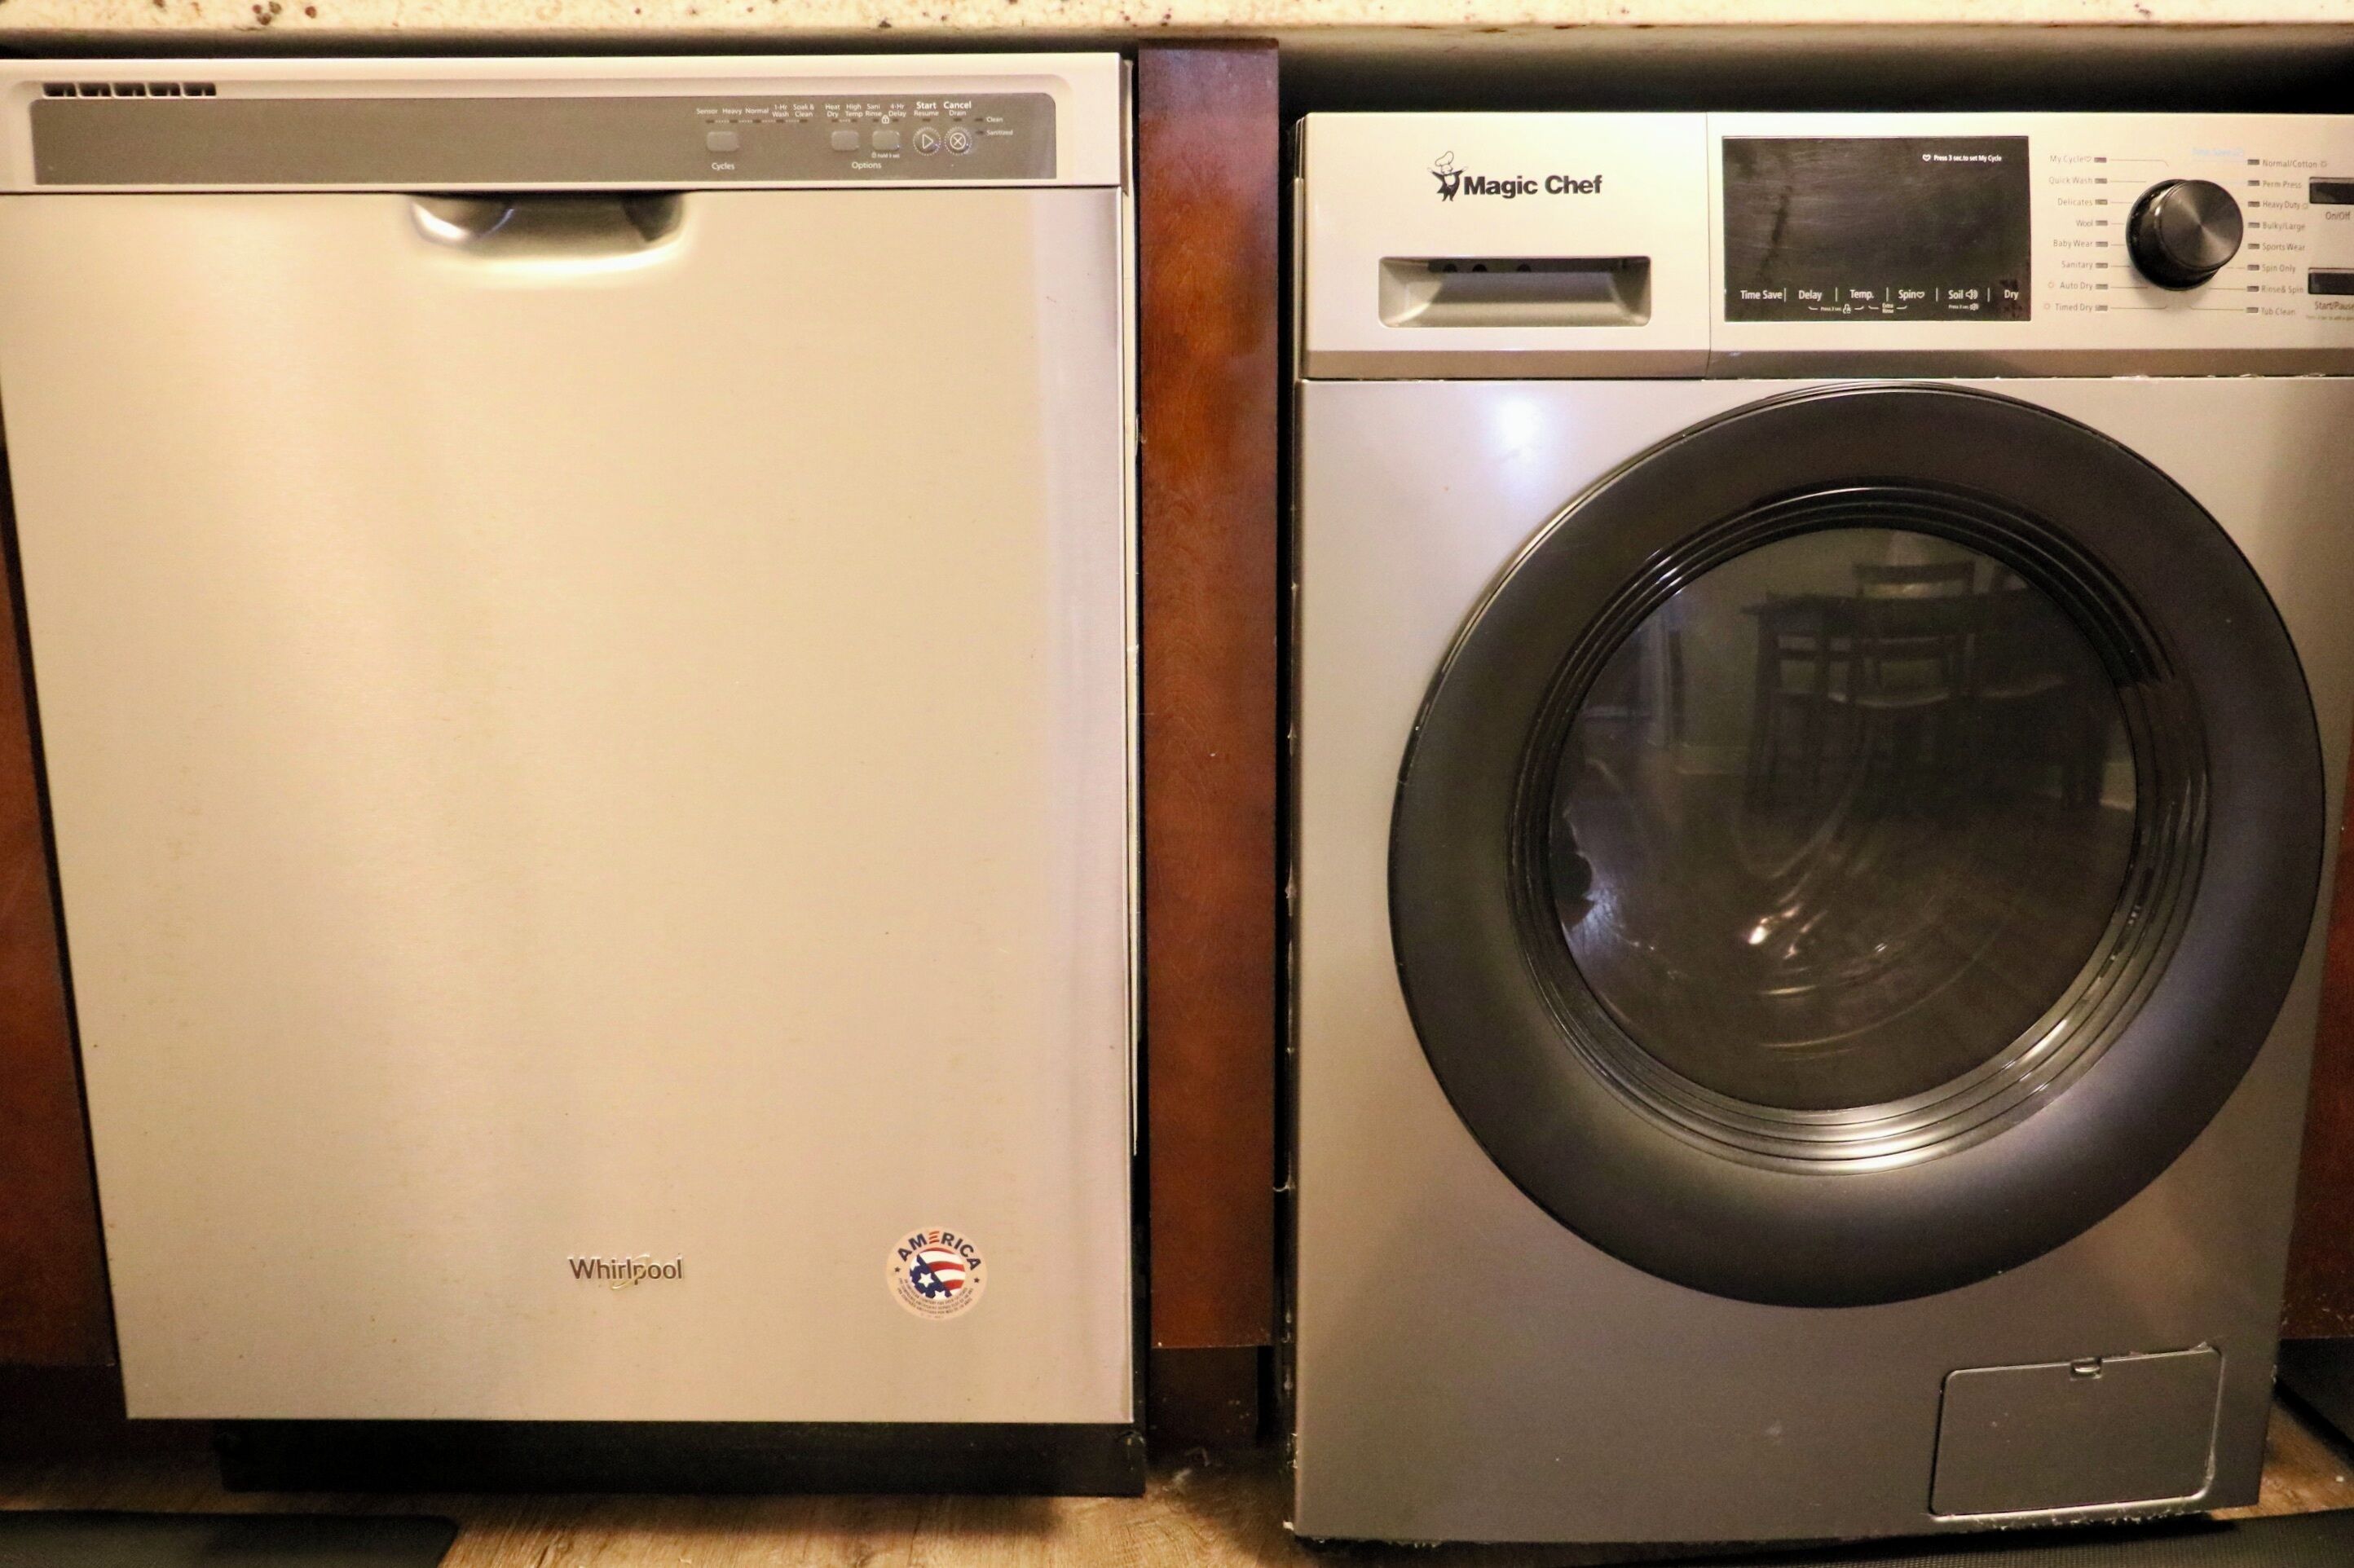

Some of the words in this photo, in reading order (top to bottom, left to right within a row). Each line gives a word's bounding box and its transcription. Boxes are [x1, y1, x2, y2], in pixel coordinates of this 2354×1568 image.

[916, 101, 937, 109] Start
[944, 101, 972, 109] Cancel
[2050, 155, 2061, 163] My
[2063, 155, 2084, 163] Cycle
[711, 162, 735, 170] Cycles
[852, 161, 882, 170] Options
[2263, 160, 2317, 168] Normal/Cotton
[2049, 176, 2070, 184] Quick
[1464, 175, 1538, 199] Magic
[1545, 174, 1602, 195] Chef
[2057, 198, 2093, 206] Delicates
[2263, 201, 2283, 209] Heavy
[2284, 201, 2300, 210] Duty
[2325, 211, 2351, 220] On/Off
[2263, 222, 2305, 232] Bulky/Large
[2053, 240, 2071, 249] Baby
[2263, 243, 2285, 251] Sports
[2061, 261, 2093, 270] Sanitary
[2262, 264, 2277, 273] Spin
[2279, 264, 2295, 273] Only
[2060, 281, 2078, 289] Auto
[2080, 281, 2093, 290] Dry
[2288, 286, 2303, 294] Spin
[1740, 290, 1761, 299] Time
[1762, 290, 1783, 299] Save
[1798, 289, 1823, 302] Delay
[1849, 289, 1874, 301] Temp.
[1898, 289, 1916, 301] Spin
[1948, 289, 1964, 299] Soil
[2004, 289, 2019, 300] Dry
[2055, 303, 2078, 311] Timed
[2080, 303, 2093, 312] Dry
[2261, 307, 2274, 315] Tub
[2275, 307, 2295, 315] Clean
[897, 1231, 981, 1271] AMERICA
[568, 1257, 683, 1285] Whirlpool
